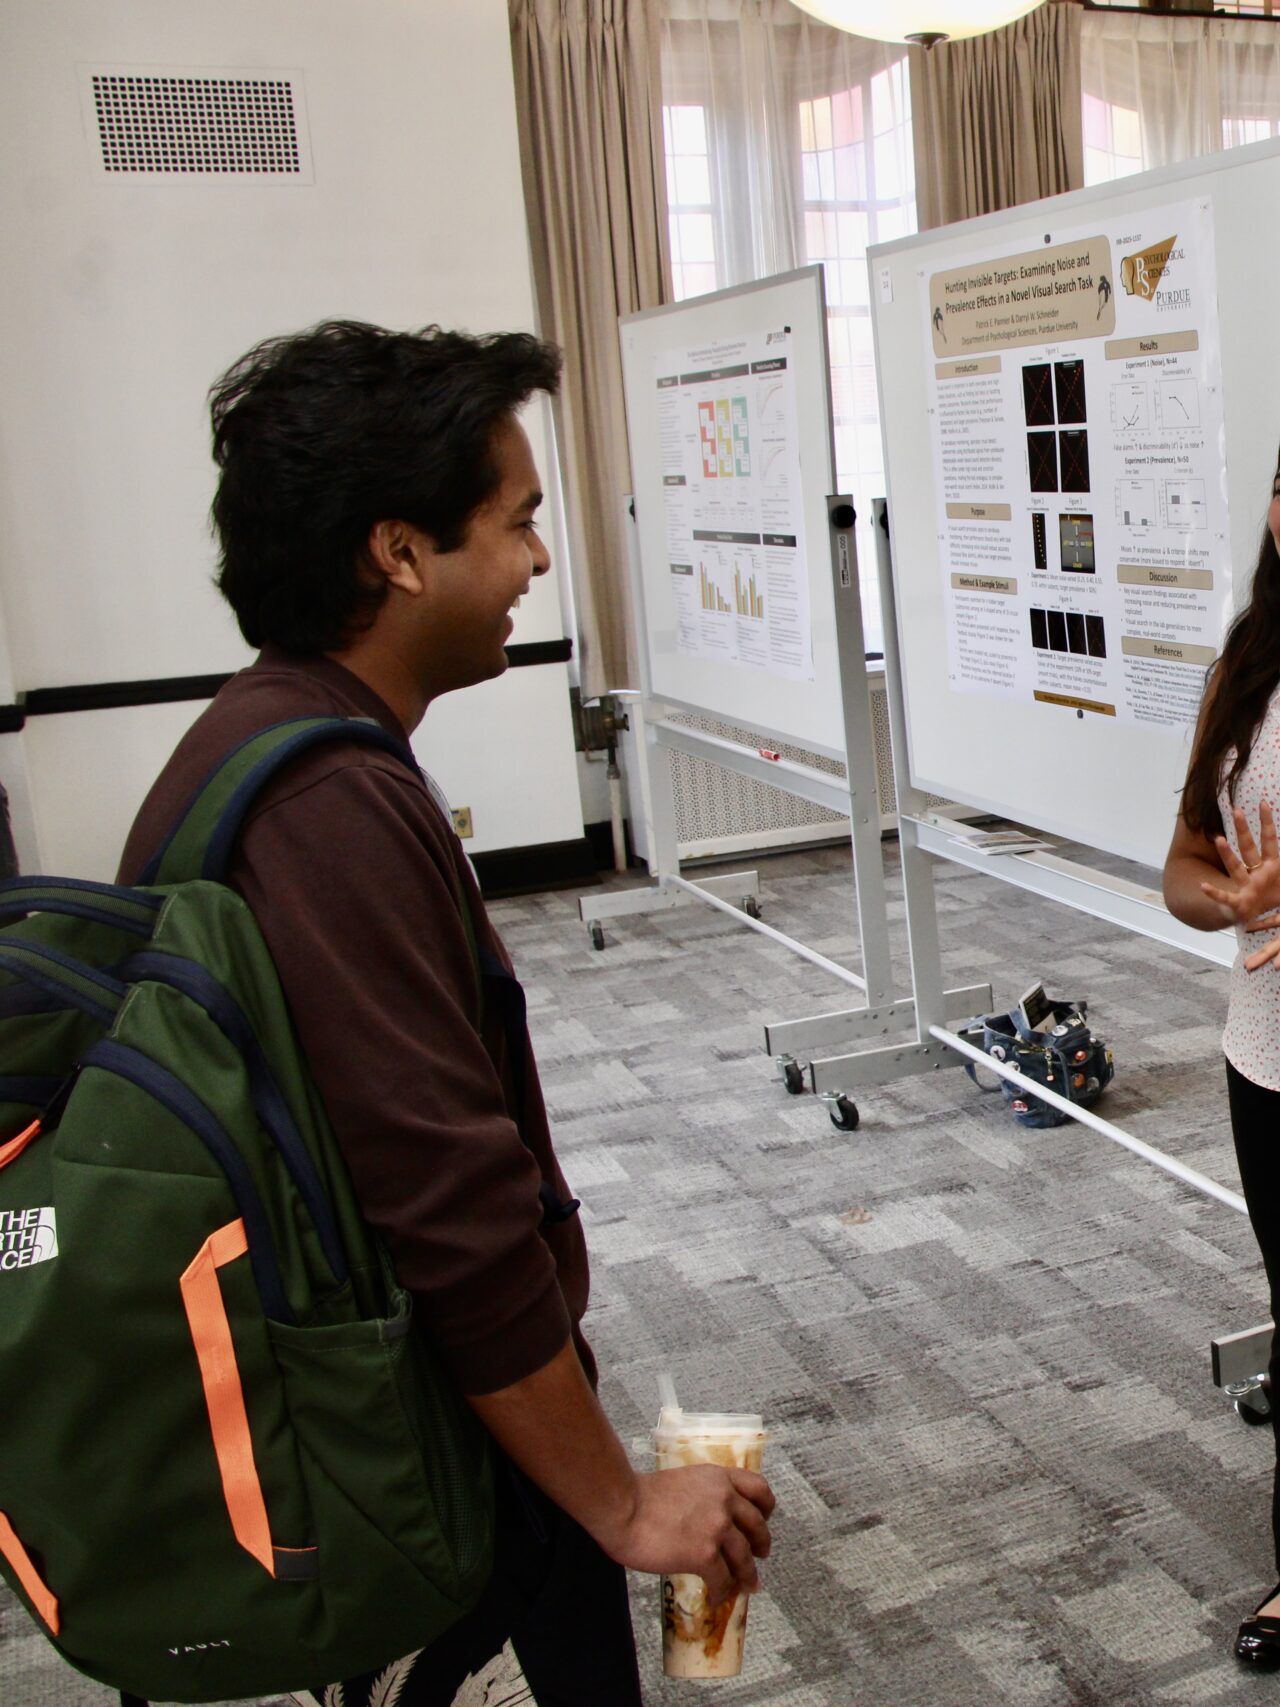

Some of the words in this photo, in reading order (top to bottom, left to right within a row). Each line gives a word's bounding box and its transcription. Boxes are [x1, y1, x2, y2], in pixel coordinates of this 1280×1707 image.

[945, 280, 967, 293] Hunting
[968, 274, 992, 289] Invisible
[994, 269, 1019, 285] Targets:
[1020, 262, 1056, 279] Examining
[1056, 258, 1075, 272] Noise
[1076, 253, 1090, 268] and
[945, 300, 976, 314] Prevalence
[976, 294, 997, 309] Effects
[998, 293, 1004, 305] in
[1011, 287, 1030, 302] Novel
[1031, 283, 1053, 299] Visual
[1054, 278, 1076, 294] Search
[1078, 275, 1094, 290] Task
[1156, 289, 1191, 305] PURDUE
[1140, 340, 1158, 350] Results
[1149, 572, 1178, 582] Discussion
[1154, 644, 1182, 658] References
[168, 1640, 230, 1655] VAULT
